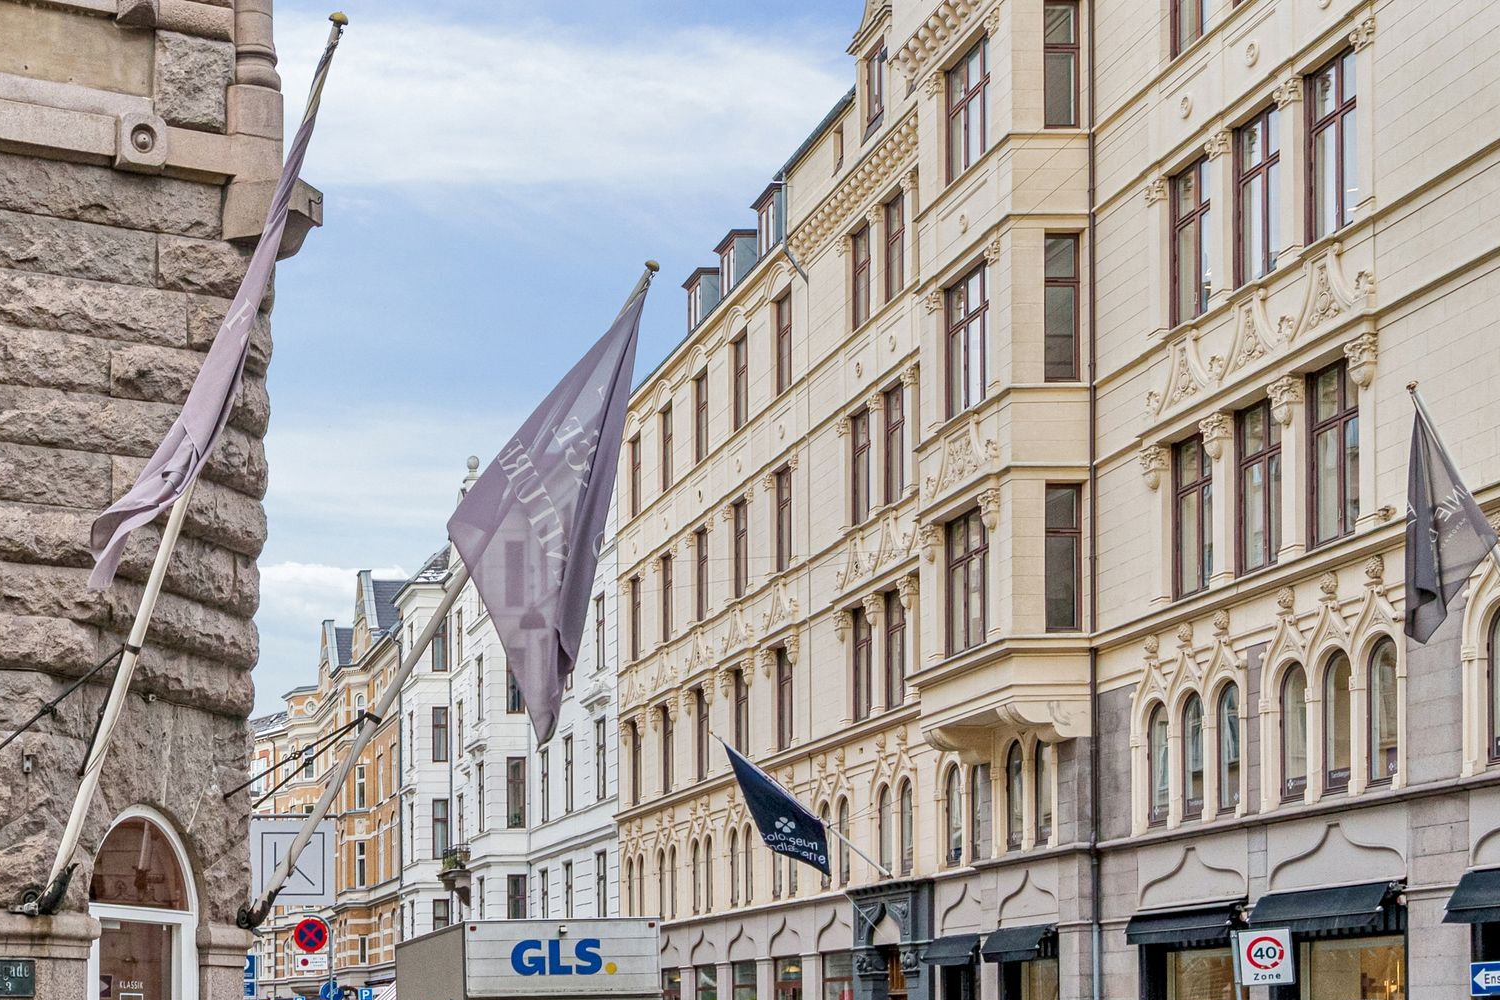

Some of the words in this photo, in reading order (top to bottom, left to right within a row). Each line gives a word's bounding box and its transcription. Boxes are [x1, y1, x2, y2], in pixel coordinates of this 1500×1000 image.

[1253, 946, 1277, 959] 40
[1253, 973, 1281, 981] Zone
[119, 981, 144, 990] KLASSIK
